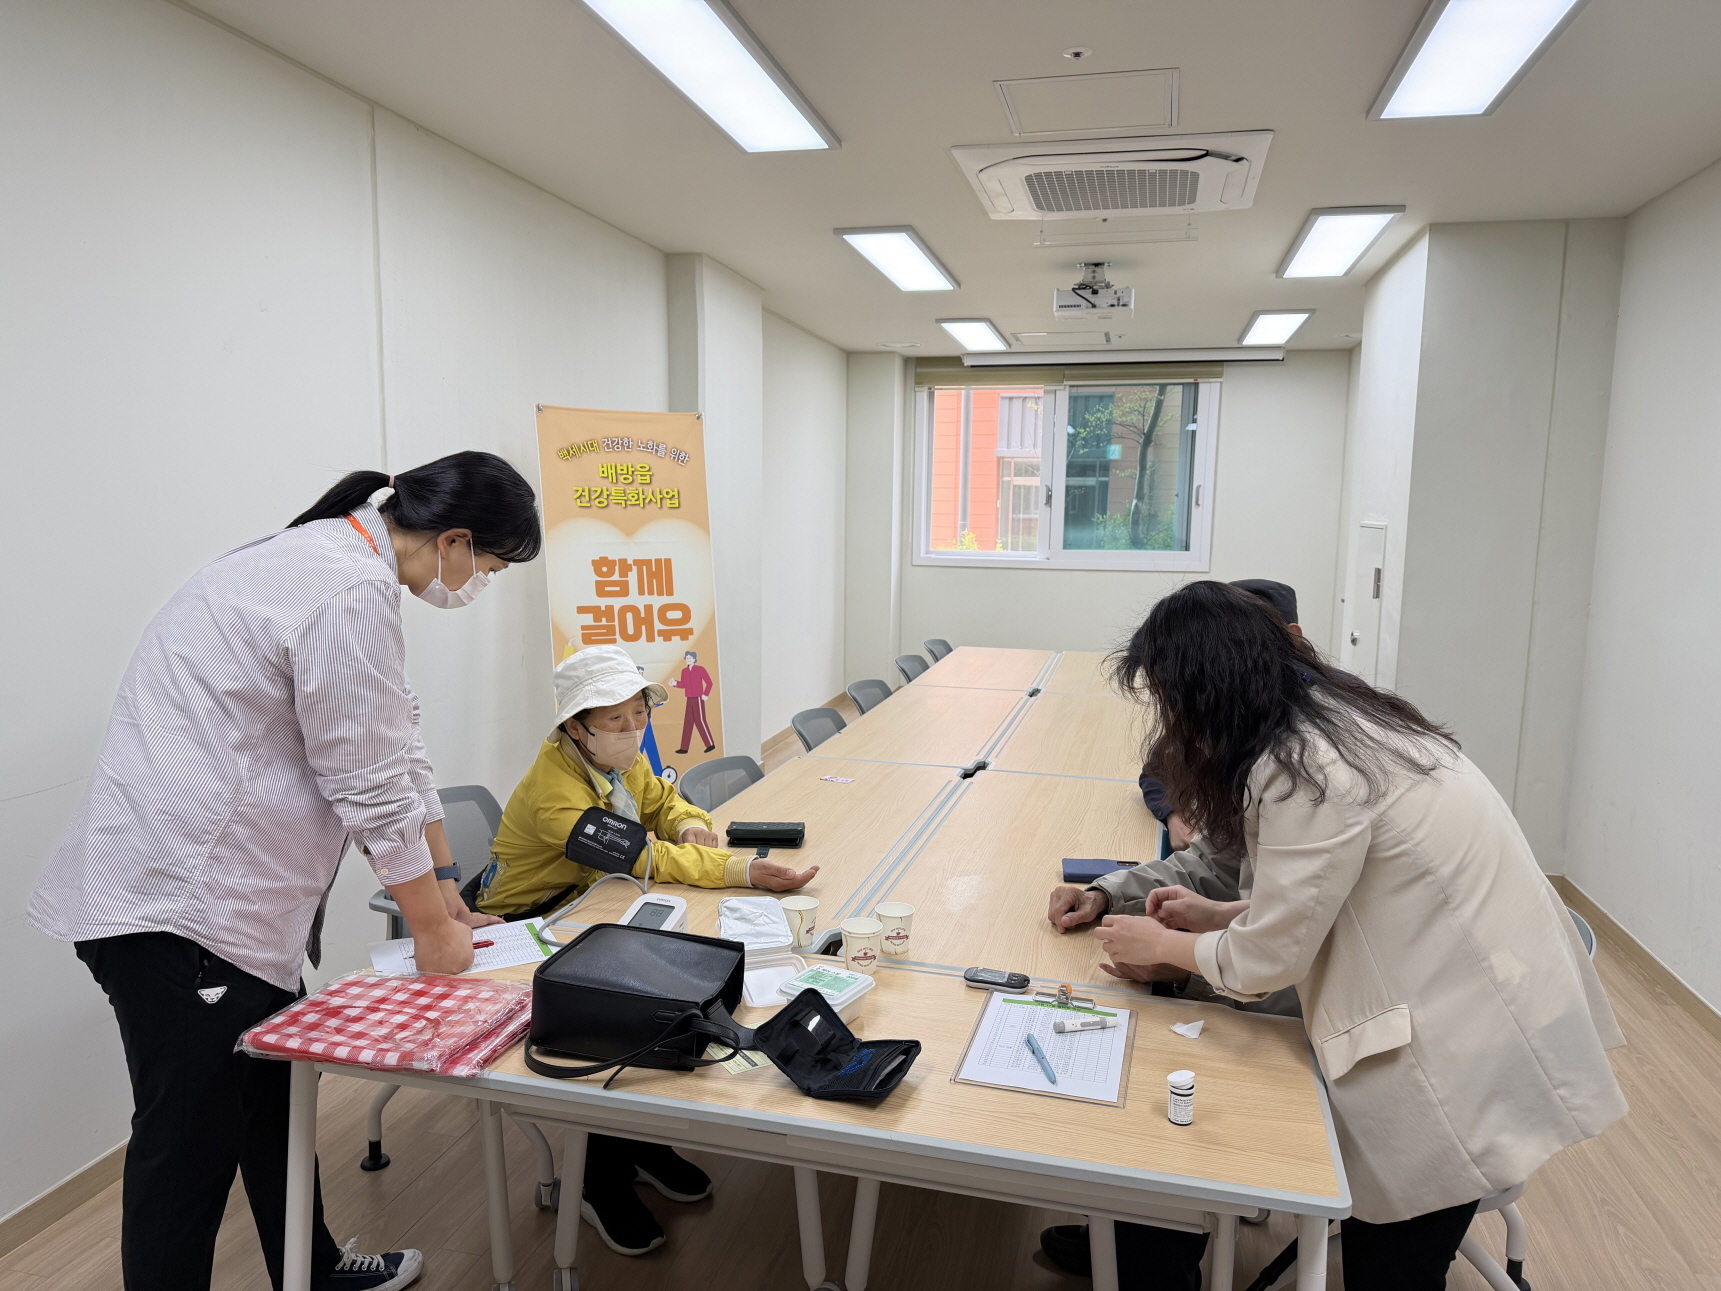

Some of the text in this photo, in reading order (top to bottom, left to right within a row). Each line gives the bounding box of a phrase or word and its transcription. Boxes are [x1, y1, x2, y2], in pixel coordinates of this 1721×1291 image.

[557, 437, 690, 466] 백세시대 건강한 노화를 위한
[598, 462, 653, 484] 배방읍
[572, 486, 681, 508] 건강특화사업
[591, 556, 674, 598] 함께
[576, 602, 694, 645] 걸어유
[602, 816, 627, 830] OMRON
